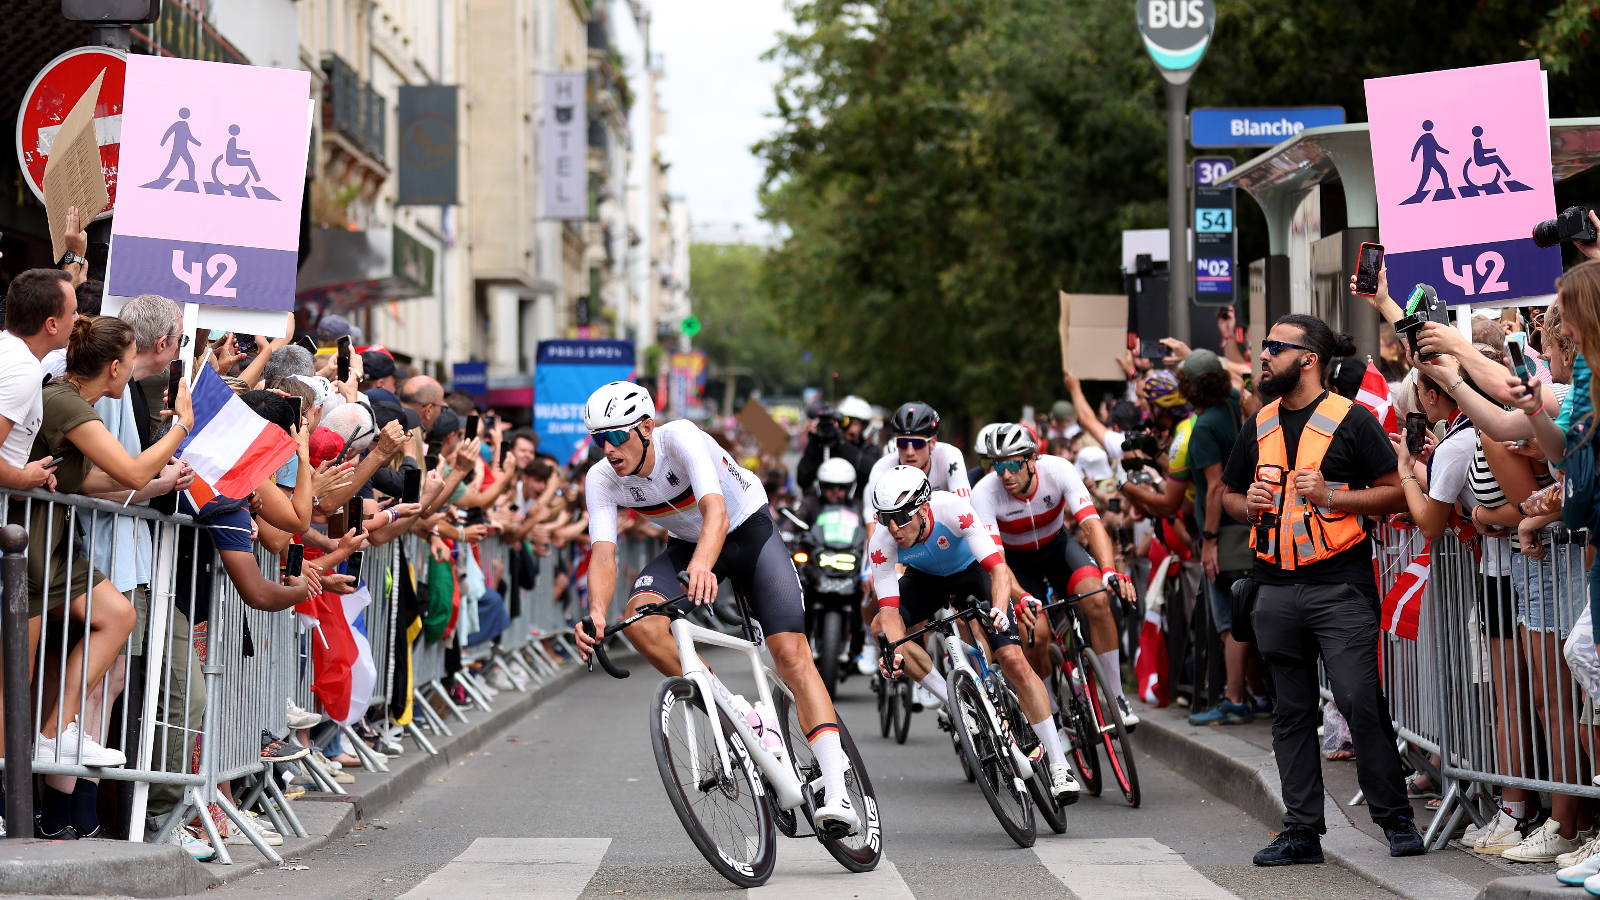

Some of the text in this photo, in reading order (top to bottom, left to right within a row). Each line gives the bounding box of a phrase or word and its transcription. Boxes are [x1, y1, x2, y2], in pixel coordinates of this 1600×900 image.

[1148, 0, 1204, 28] BUS
[1230, 118, 1304, 136] Blanche
[1199, 162, 1228, 184] 30
[1202, 211, 1228, 230] 54
[172, 250, 238, 298] 42
[1442, 251, 1509, 295] 42
[547, 346, 586, 358] PARIS
[727, 463, 752, 492] GERMANY
[711, 677, 768, 752] COLNAGO
